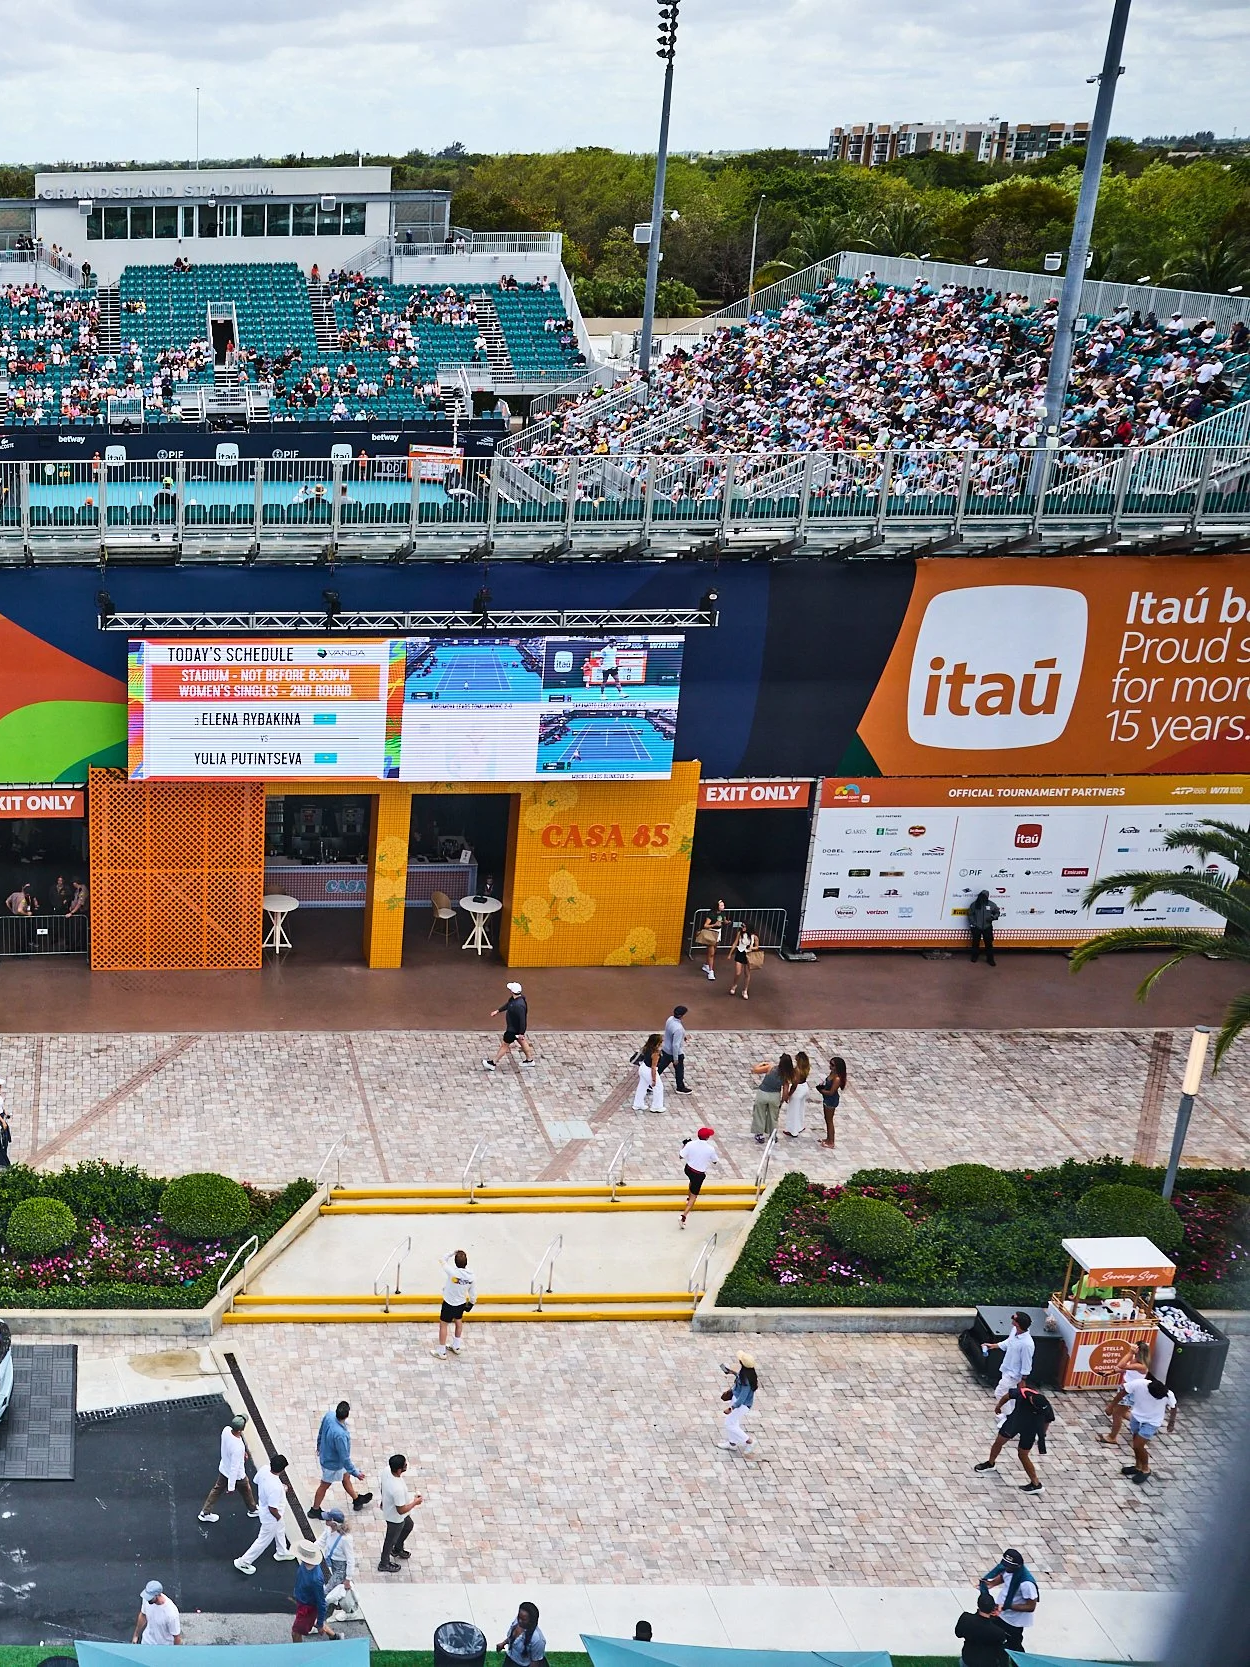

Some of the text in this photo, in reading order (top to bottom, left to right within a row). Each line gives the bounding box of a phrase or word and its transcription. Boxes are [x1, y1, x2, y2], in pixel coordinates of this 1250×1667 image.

[42, 183, 272, 199] GRANDSTAND STADIUM
[58, 435, 85, 444] betway
[371, 434, 399, 442] betway
[168, 450, 184, 459] PIF
[283, 450, 299, 459] PIF
[1125, 587, 1210, 625] Itaú
[1118, 627, 1233, 664] Proud
[168, 646, 294, 662] TODAY'S SCHEDULE
[327, 649, 365, 657] VANDA
[181, 669, 229, 682] STADIUM
[241, 669, 263, 681] NOT
[266, 669, 306, 681] BEFORE
[308, 669, 350, 682] 8:30PM
[178, 684, 231, 697] WOMEN'S
[233, 684, 278, 697] SINGLES
[290, 684, 312, 697] 2ND
[315, 684, 352, 696] ROUND
[923, 656, 1062, 716] itaú
[1110, 667, 1250, 704] for mor
[201, 712, 238, 726] ELENA
[243, 712, 301, 726] RYBAKINA
[1105, 709, 1250, 750] 15 years.
[194, 752, 302, 765] YULIA PUTINTSEVA
[706, 785, 801, 802] EXIT ONLY
[948, 787, 1126, 797] OFFICIAL TOURNAMENT PARTNERS
[26, 795, 76, 811] ONLY
[541, 822, 671, 849] CASA 85
[1016, 833, 1039, 844] itaú
[590, 851, 619, 863] BAR
[968, 869, 983, 877] PIF
[1137, 1270, 1159, 1281] Sips
